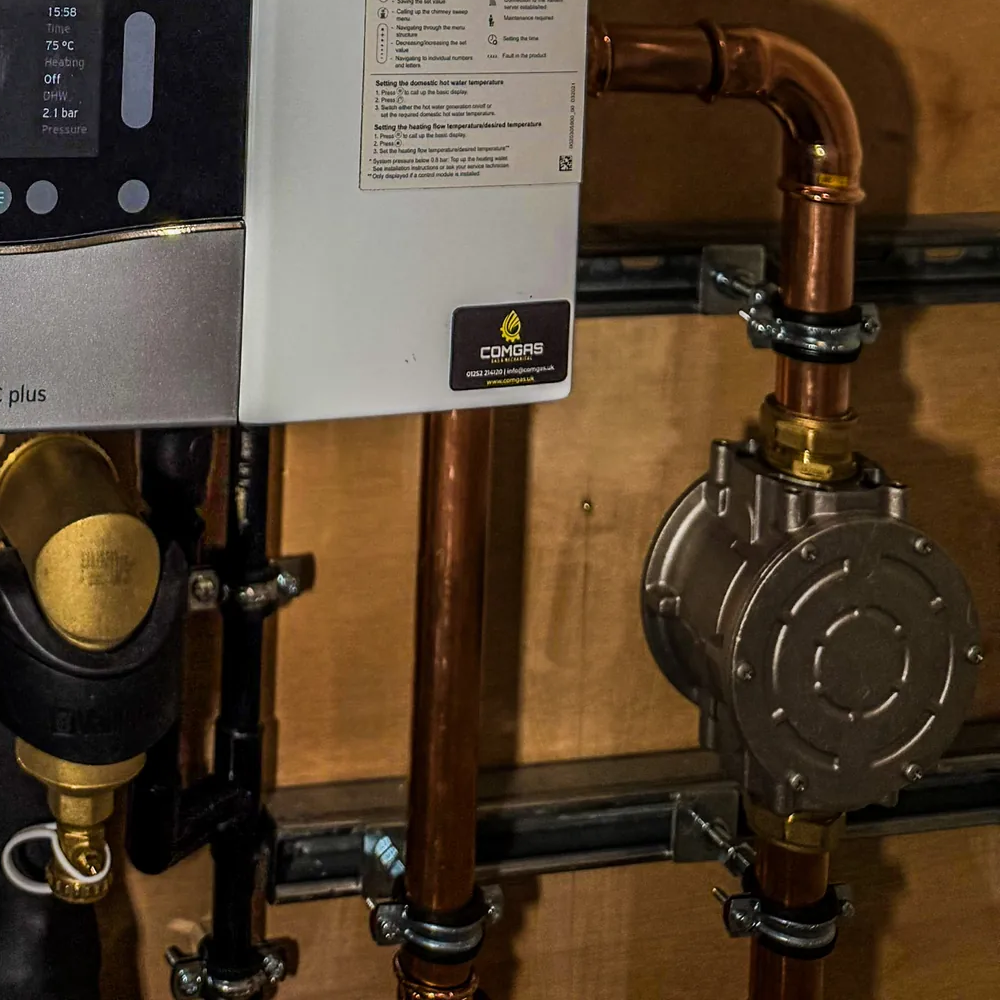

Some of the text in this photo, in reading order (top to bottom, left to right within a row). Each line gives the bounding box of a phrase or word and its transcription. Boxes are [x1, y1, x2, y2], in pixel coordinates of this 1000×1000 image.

[48, 6, 77, 18] 15:58
[46, 23, 71, 34] Time
[46, 40, 60, 51] 75
[44, 56, 85, 71] Heating
[44, 73, 62, 85] Off
[376, 80, 397, 88] Setting
[469, 79, 504, 87] temperature
[43, 90, 68, 102] DHW
[42, 107, 79, 119] 2.1 bar
[41, 124, 88, 135] Pressure
[374, 123, 396, 131] Setting
[409, 123, 431, 131] heating
[447, 121, 505, 130] temperature/desired
[507, 121, 542, 129] temperature
[480, 342, 544, 360] COMGAS
[466, 364, 555, 378] 01252 214120 info@comgas.uk
[486, 376, 535, 386] www.comgas.uk
[9, 384, 47, 408] plus
